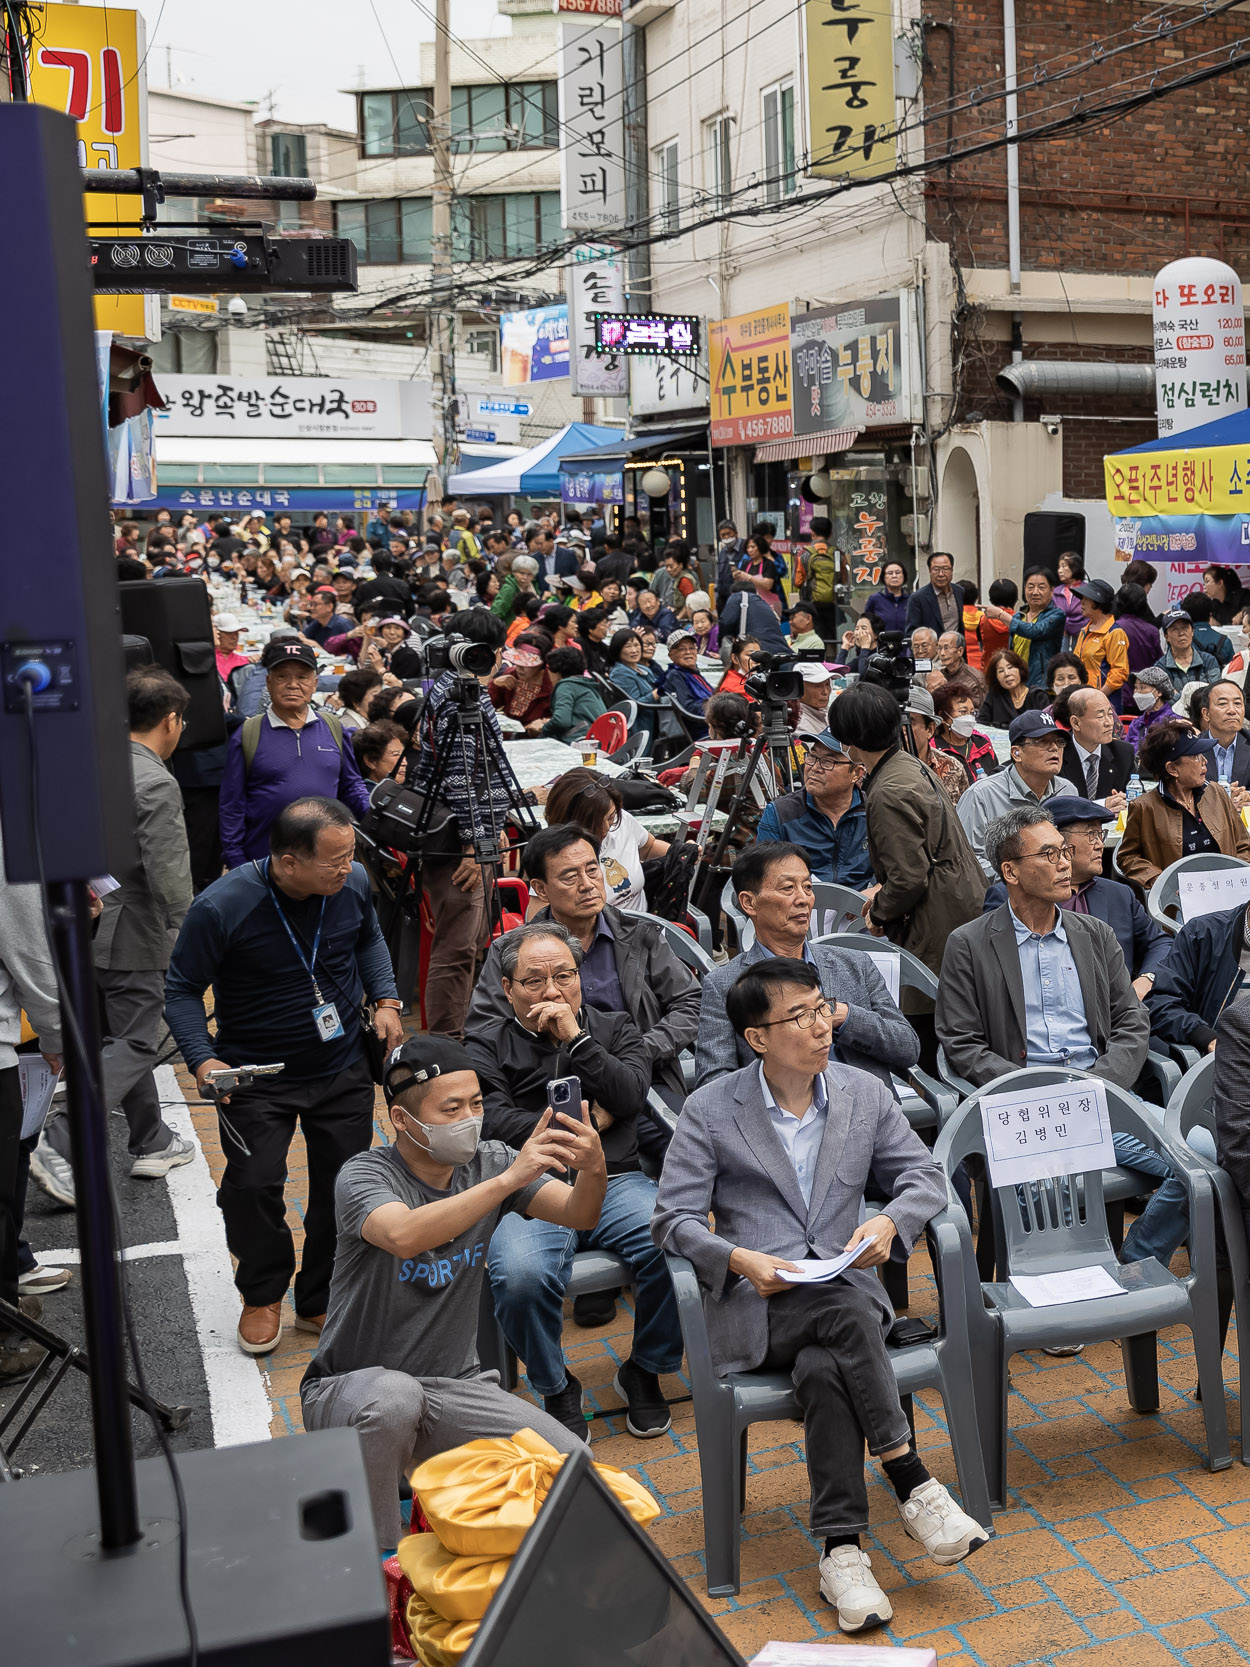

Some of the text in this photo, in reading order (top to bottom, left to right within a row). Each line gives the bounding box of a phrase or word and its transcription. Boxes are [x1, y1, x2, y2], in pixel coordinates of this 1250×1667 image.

[577, 39, 612, 207] 기린모피
[1155, 284, 1236, 308] 다 또오리
[1178, 319, 1199, 331] 국산
[797, 328, 894, 398] 가마솥 누룽지
[722, 350, 788, 416] 수부동산
[1161, 379, 1240, 409] 점심런치
[746, 415, 791, 438] 456-7880
[1112, 459, 1214, 505] 오픈1주년행사
[180, 490, 290, 506] 소문난순대국
[851, 493, 886, 509] 고향
[854, 512, 884, 585] 누룽지
[998, 1097, 1091, 1126] 당협위원장
[1015, 1123, 1068, 1145] 김병민
